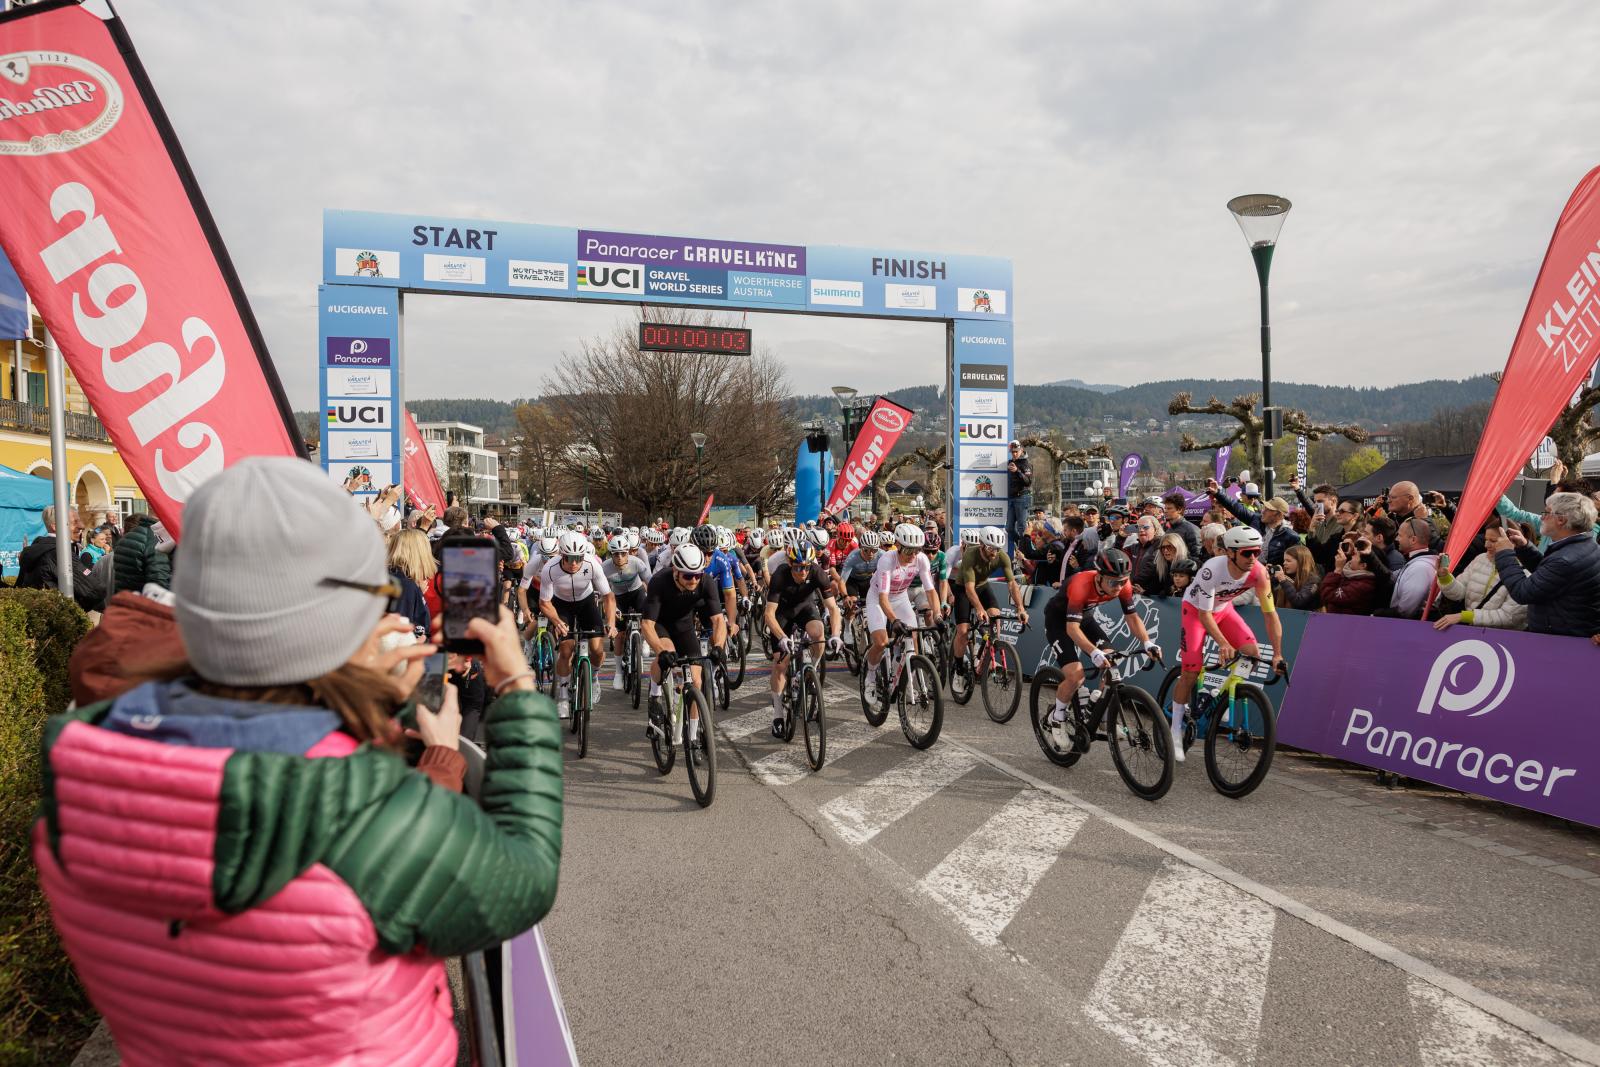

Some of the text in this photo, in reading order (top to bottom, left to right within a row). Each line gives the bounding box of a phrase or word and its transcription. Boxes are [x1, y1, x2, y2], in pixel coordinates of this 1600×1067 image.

[412, 225, 498, 251] START
[586, 238, 798, 269] Panaracer GRAVELKING
[649, 270, 690, 282] GRAVEL
[872, 257, 947, 280] FINISH
[588, 266, 640, 289] UCI
[733, 276, 803, 289] WOERTHERSEE
[649, 281, 723, 295] WORLD SERIES
[733, 287, 773, 297] AUSTRIA
[813, 288, 861, 298] SHIMANO
[328, 304, 389, 315] #UCIGRAVEL
[334, 354, 382, 364] Panaracer
[338, 406, 384, 423] UCI
[967, 423, 1003, 439] UCI
[1341, 707, 1577, 798] Panaracer
